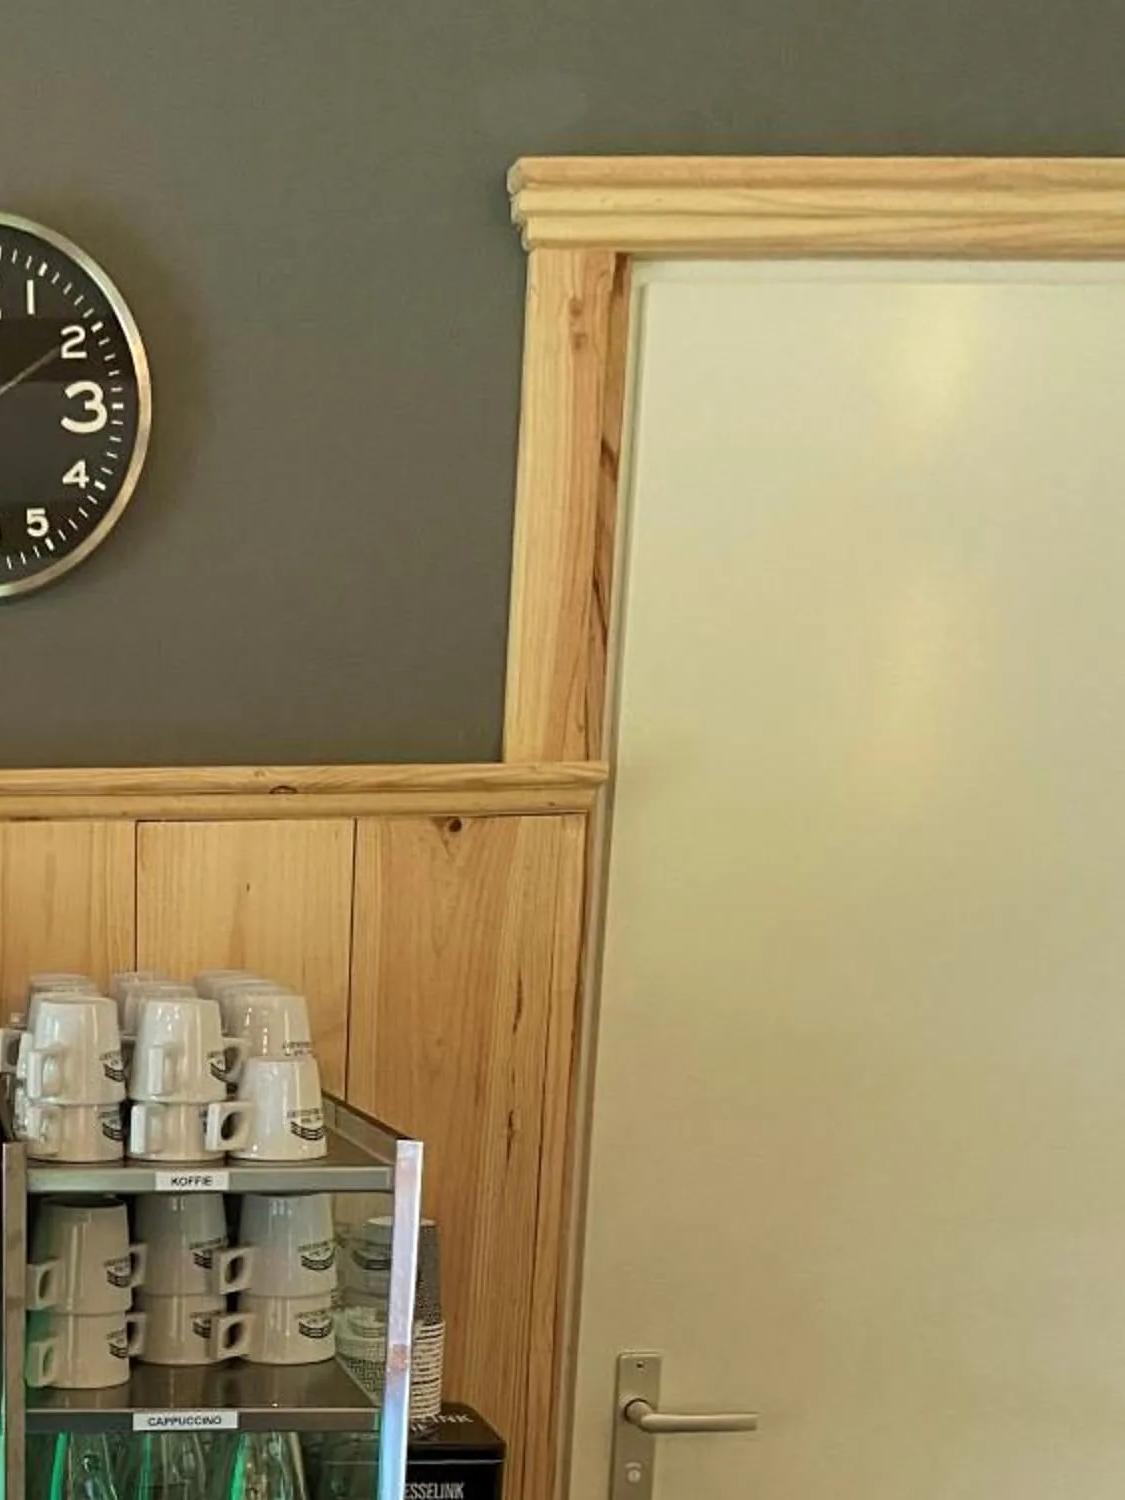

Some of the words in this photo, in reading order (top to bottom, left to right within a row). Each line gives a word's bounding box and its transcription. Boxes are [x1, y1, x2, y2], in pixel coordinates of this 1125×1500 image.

[26, 279, 36, 315] 1
[60, 324, 87, 359] 2
[60, 380, 108, 433] 3
[62, 459, 90, 489] 4
[26, 507, 50, 538] 5
[170, 1175, 213, 1187] KOFFIE
[147, 1414, 222, 1426] CAPPUCCINO
[404, 1482, 465, 1499] ESSELINK
